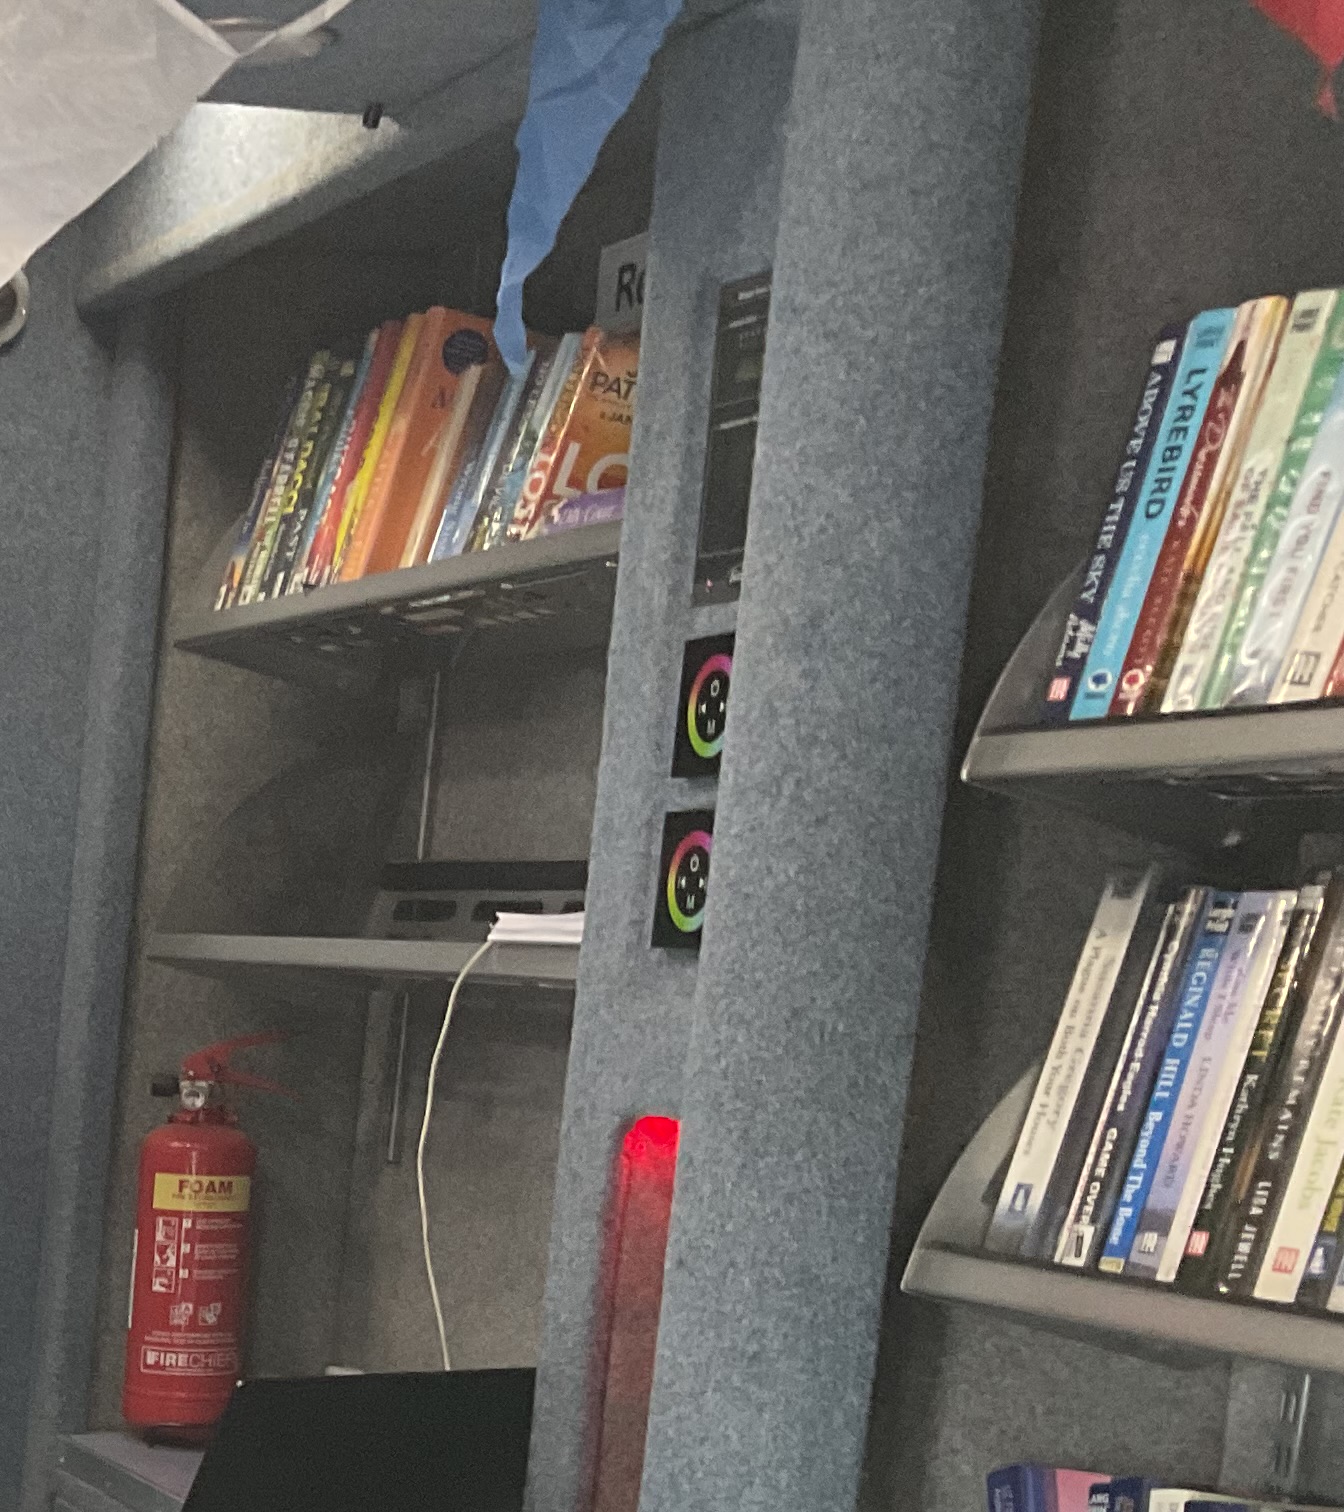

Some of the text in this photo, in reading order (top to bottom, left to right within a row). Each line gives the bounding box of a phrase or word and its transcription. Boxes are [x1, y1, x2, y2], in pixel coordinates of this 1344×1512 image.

[1145, 368, 1209, 520] LYREBIRD
[1080, 371, 1162, 603] ABOVE US THE SKY
[1155, 946, 1219, 1099] REGINALD HILL
[1094, 1127, 1118, 1180] GAME
[1131, 1111, 1163, 1170] Beyond
[178, 1179, 234, 1195] FOAM
[1122, 1172, 1144, 1204] The
[1228, 1181, 1273, 1280] LISA JEWELL
